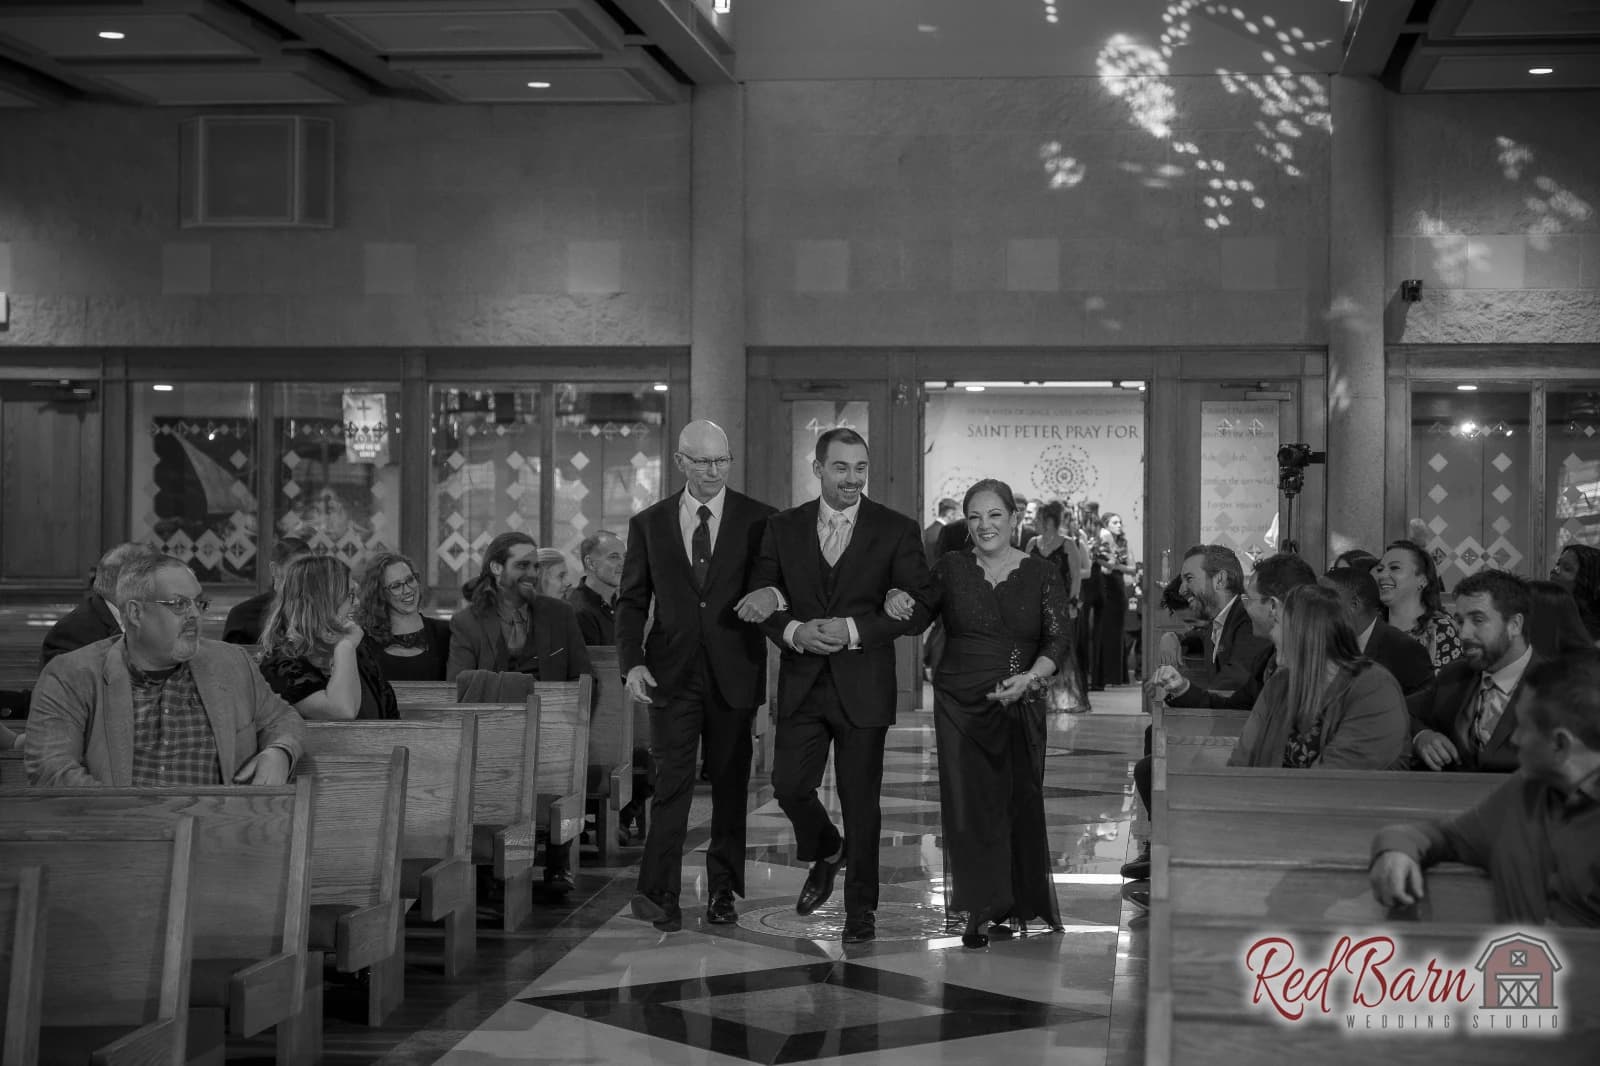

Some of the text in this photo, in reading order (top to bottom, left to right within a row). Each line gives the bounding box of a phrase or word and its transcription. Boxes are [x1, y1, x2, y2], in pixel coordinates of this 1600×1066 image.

[967, 423, 1139, 440] SAINT PETER PRAY FOR
